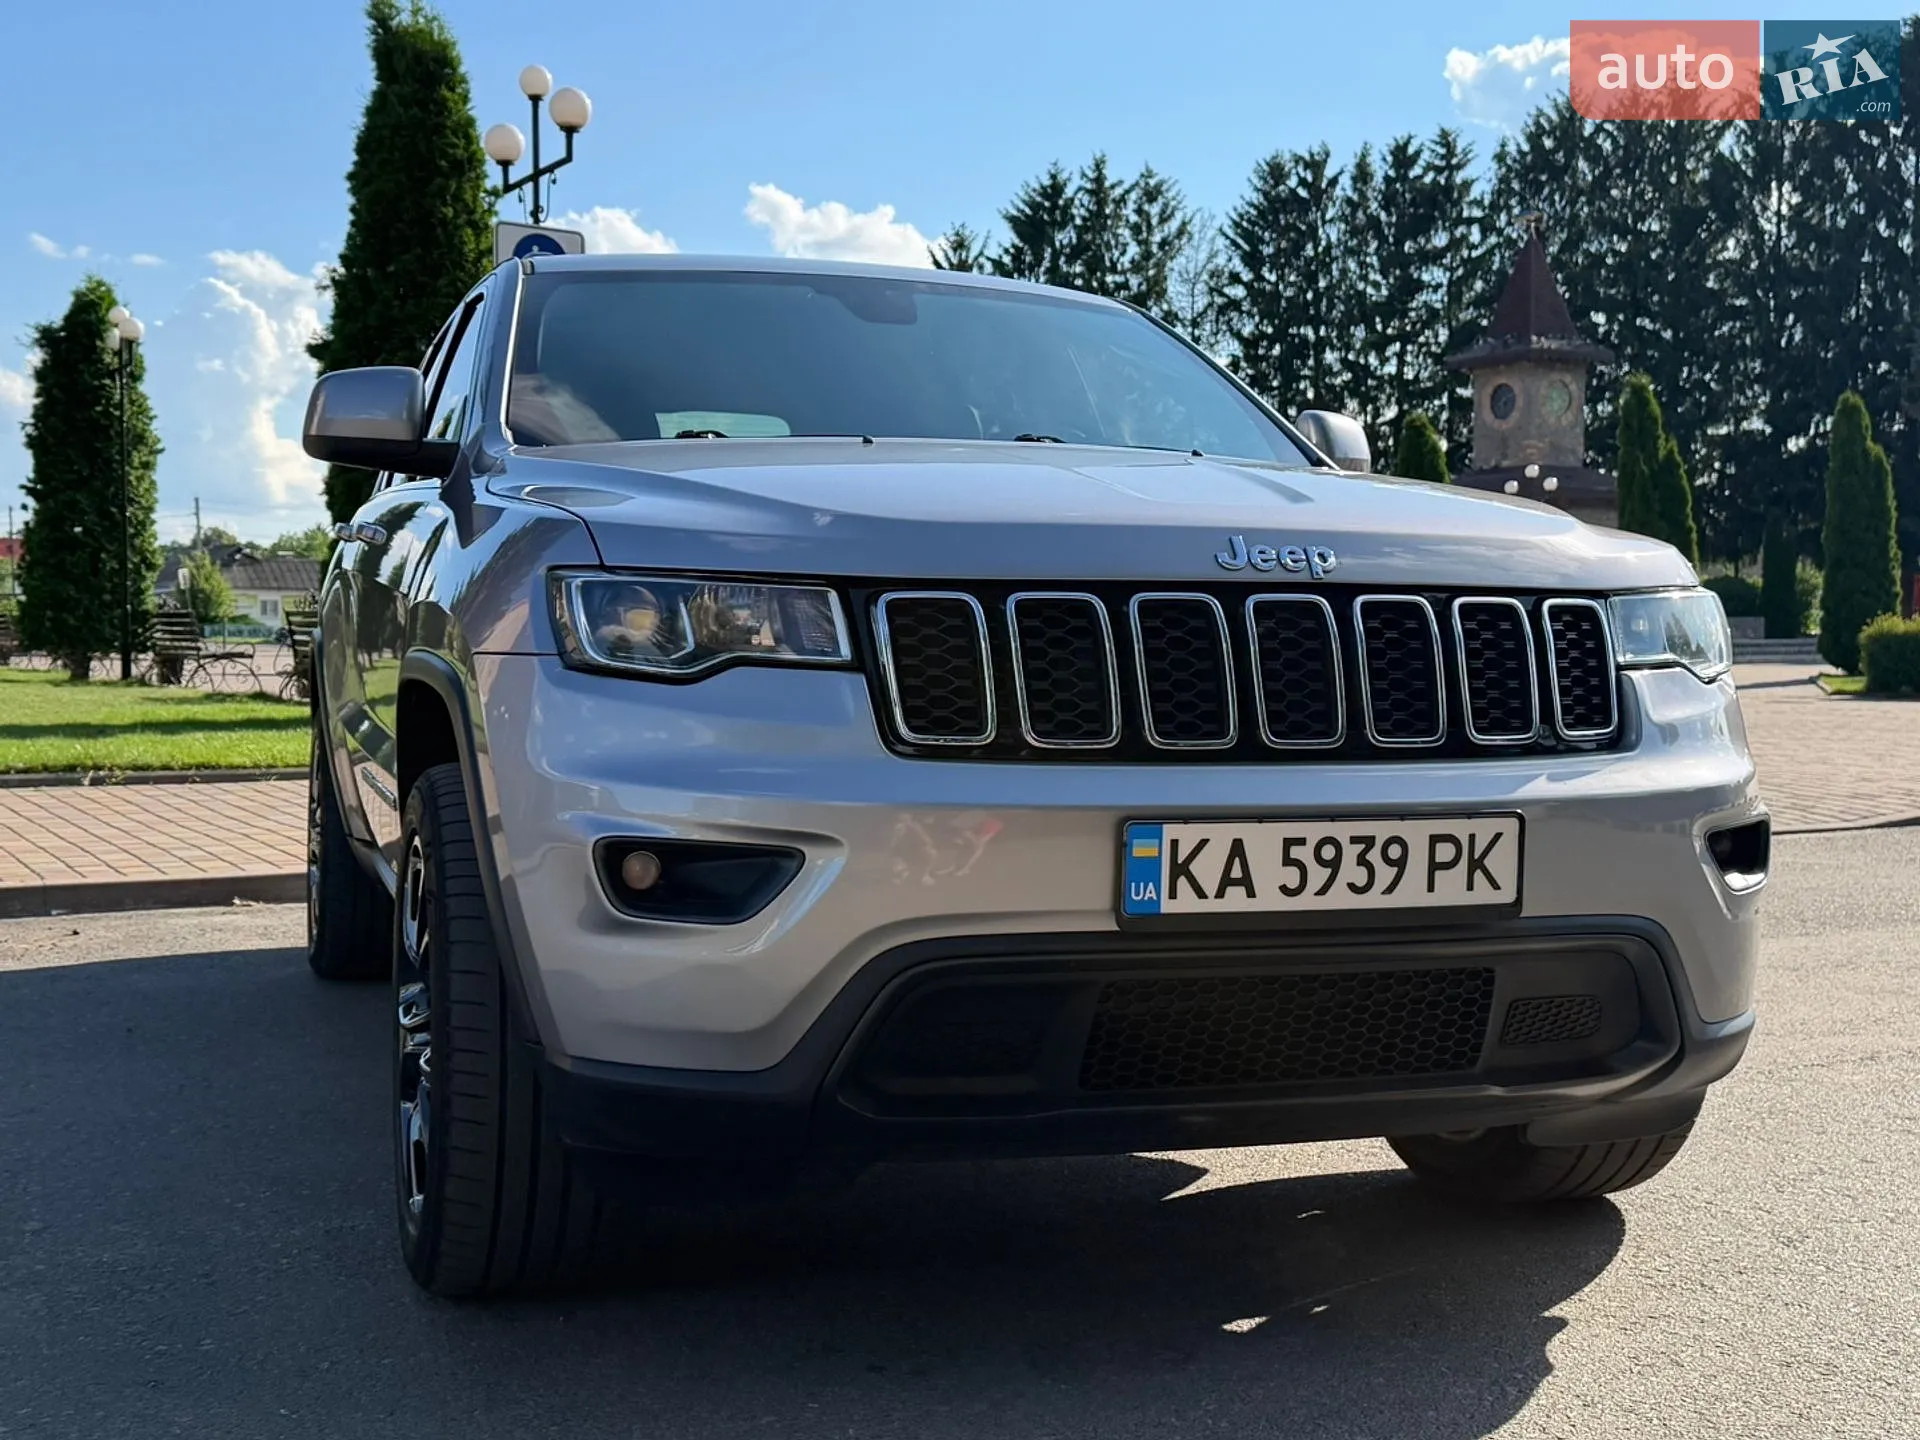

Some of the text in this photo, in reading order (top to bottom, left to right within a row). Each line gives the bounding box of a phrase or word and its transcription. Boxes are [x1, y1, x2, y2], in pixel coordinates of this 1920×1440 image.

[1215, 535, 1336, 579] Jeep
[1168, 832, 1504, 899] KA 5939 PK
[1131, 881, 1157, 901] UA
